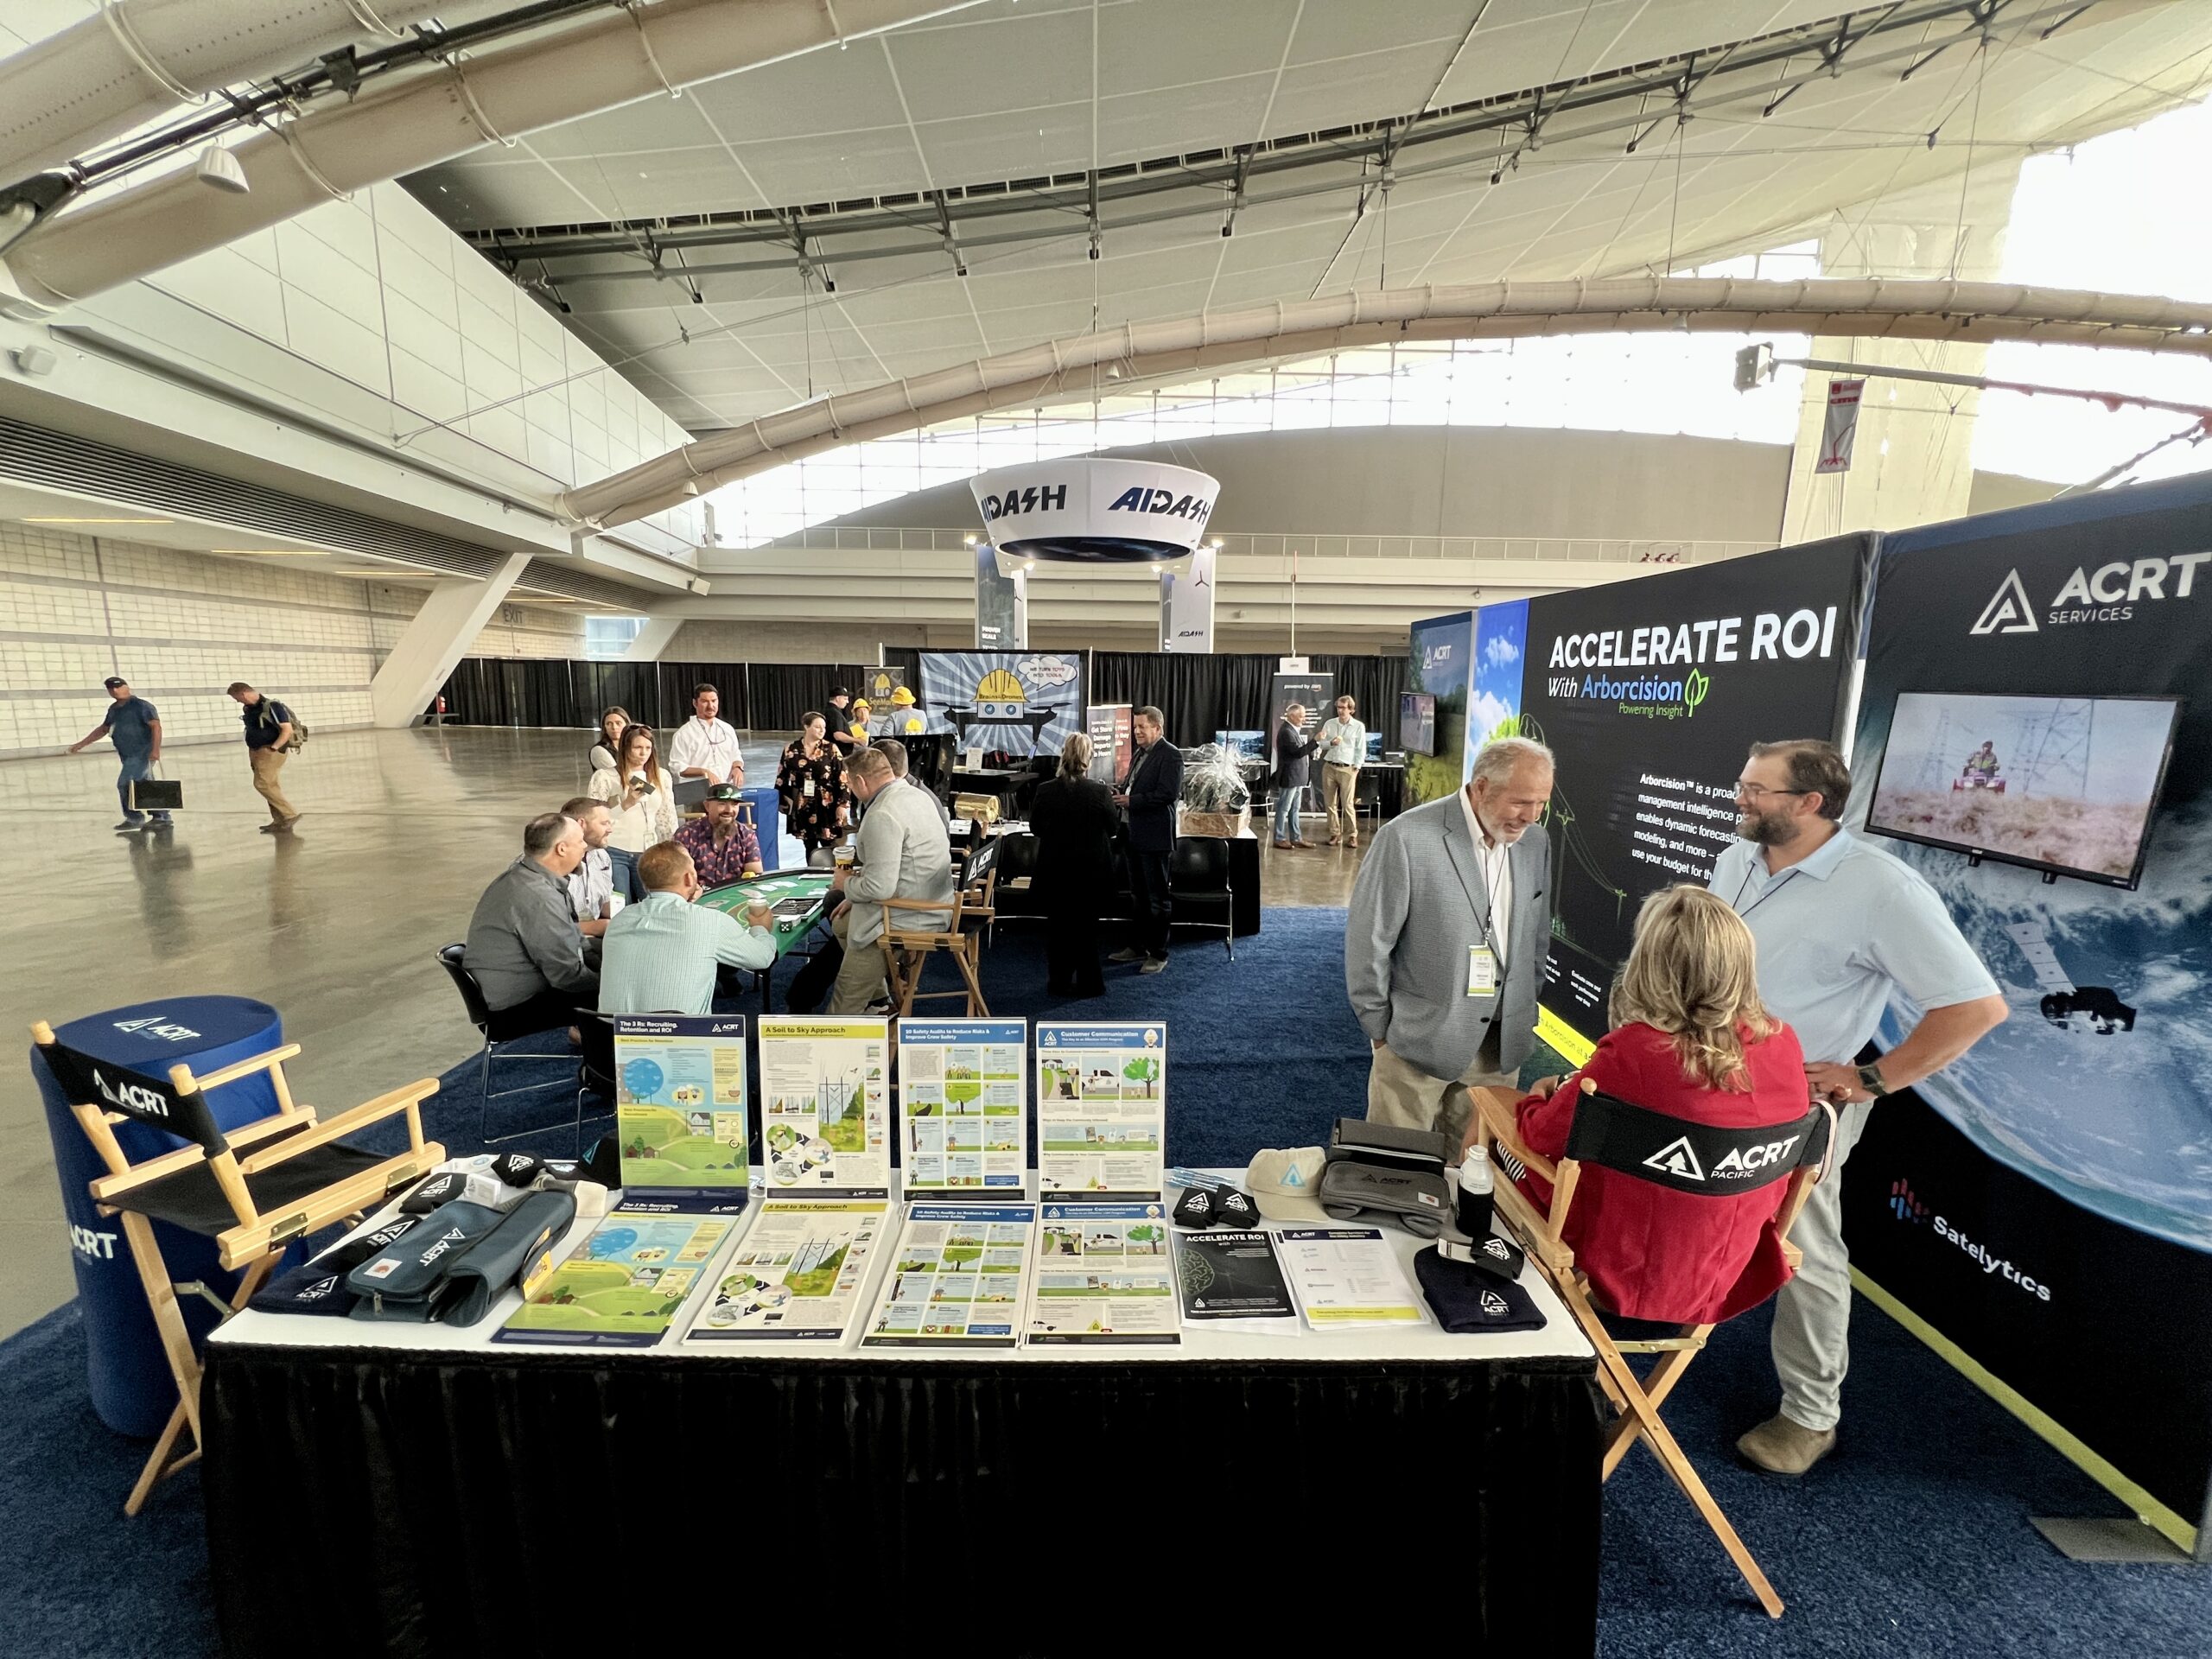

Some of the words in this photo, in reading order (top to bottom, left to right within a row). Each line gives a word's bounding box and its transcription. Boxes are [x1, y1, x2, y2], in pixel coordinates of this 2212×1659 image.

[2051, 552, 2212, 607] ACRT
[504, 608, 524, 624] EXIT
[2048, 607, 2133, 625] SERVICES
[1548, 617, 1742, 669] ACCELERATE
[1751, 607, 1838, 660] ROI
[1433, 645, 1452, 660] ACRT
[1548, 677, 1578, 698] With
[1580, 674, 1682, 702] Arborcision
[1618, 702, 1654, 719] Powering
[1656, 703, 1684, 721] Insight
[1696, 783, 1703, 794] is
[1705, 786, 1711, 796] a
[1638, 793, 1685, 811] management
[1687, 802, 1734, 822] intelligence
[1636, 812, 1663, 826] enables
[1664, 817, 1697, 835] dynamic
[1634, 830, 1668, 849] modeling,
[1669, 840, 1684, 851] and
[1686, 844, 1707, 858] more
[977, 848, 994, 868] ACRT
[1632, 849, 1644, 860] use
[1645, 853, 1662, 863] your
[1662, 855, 1689, 874] budget
[1691, 865, 1702, 877] for
[148, 1024, 201, 1041] ACRT
[118, 1082, 169, 1117] ACRT
[1714, 1135, 1800, 1171] ACRT
[1379, 1177, 1412, 1185] ACRT
[1710, 1169, 1756, 1179] PACIFIC
[419, 1187, 447, 1197] ACRT
[1185, 1202, 1210, 1212] ACRT
[1224, 1200, 1250, 1212] ACRT
[419, 1240, 450, 1267] ACRT
[1483, 1245, 1510, 1261] ACRT
[1933, 1215, 2051, 1301] Satelytics
